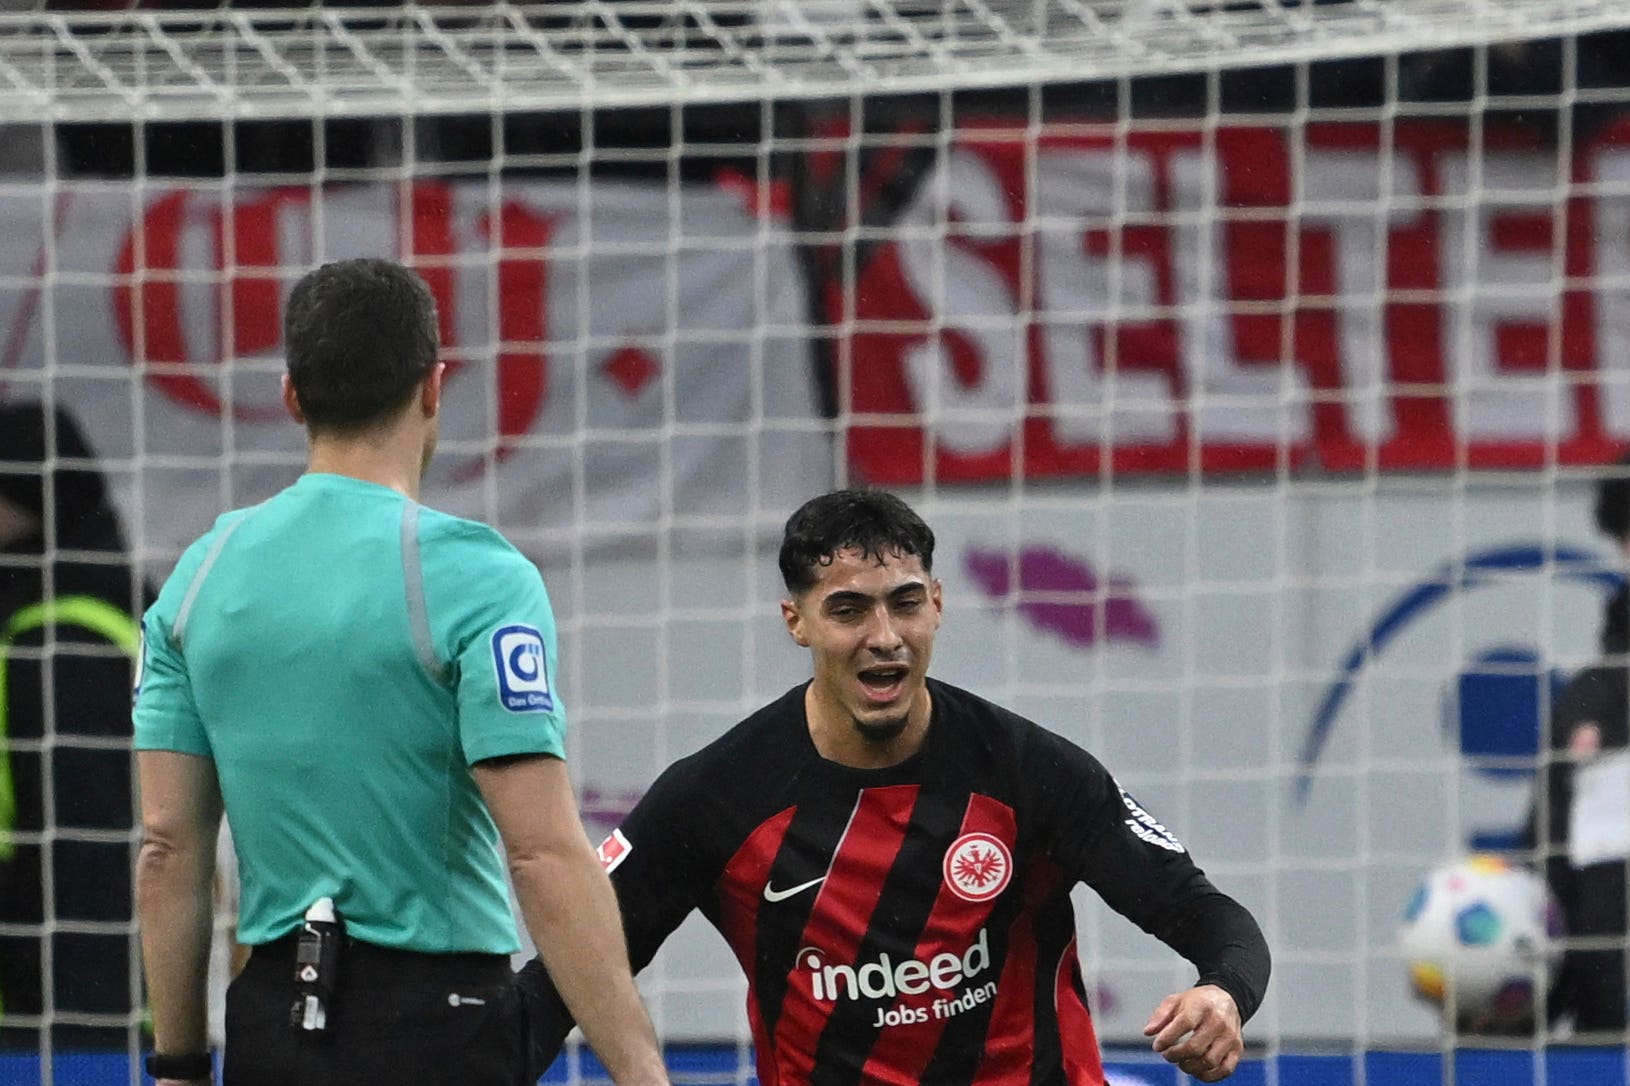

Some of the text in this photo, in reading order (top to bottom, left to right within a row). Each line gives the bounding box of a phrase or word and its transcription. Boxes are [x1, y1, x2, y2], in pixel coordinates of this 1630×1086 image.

[807, 928, 990, 1000] indeed
[872, 981, 998, 1028] Jobs finden
